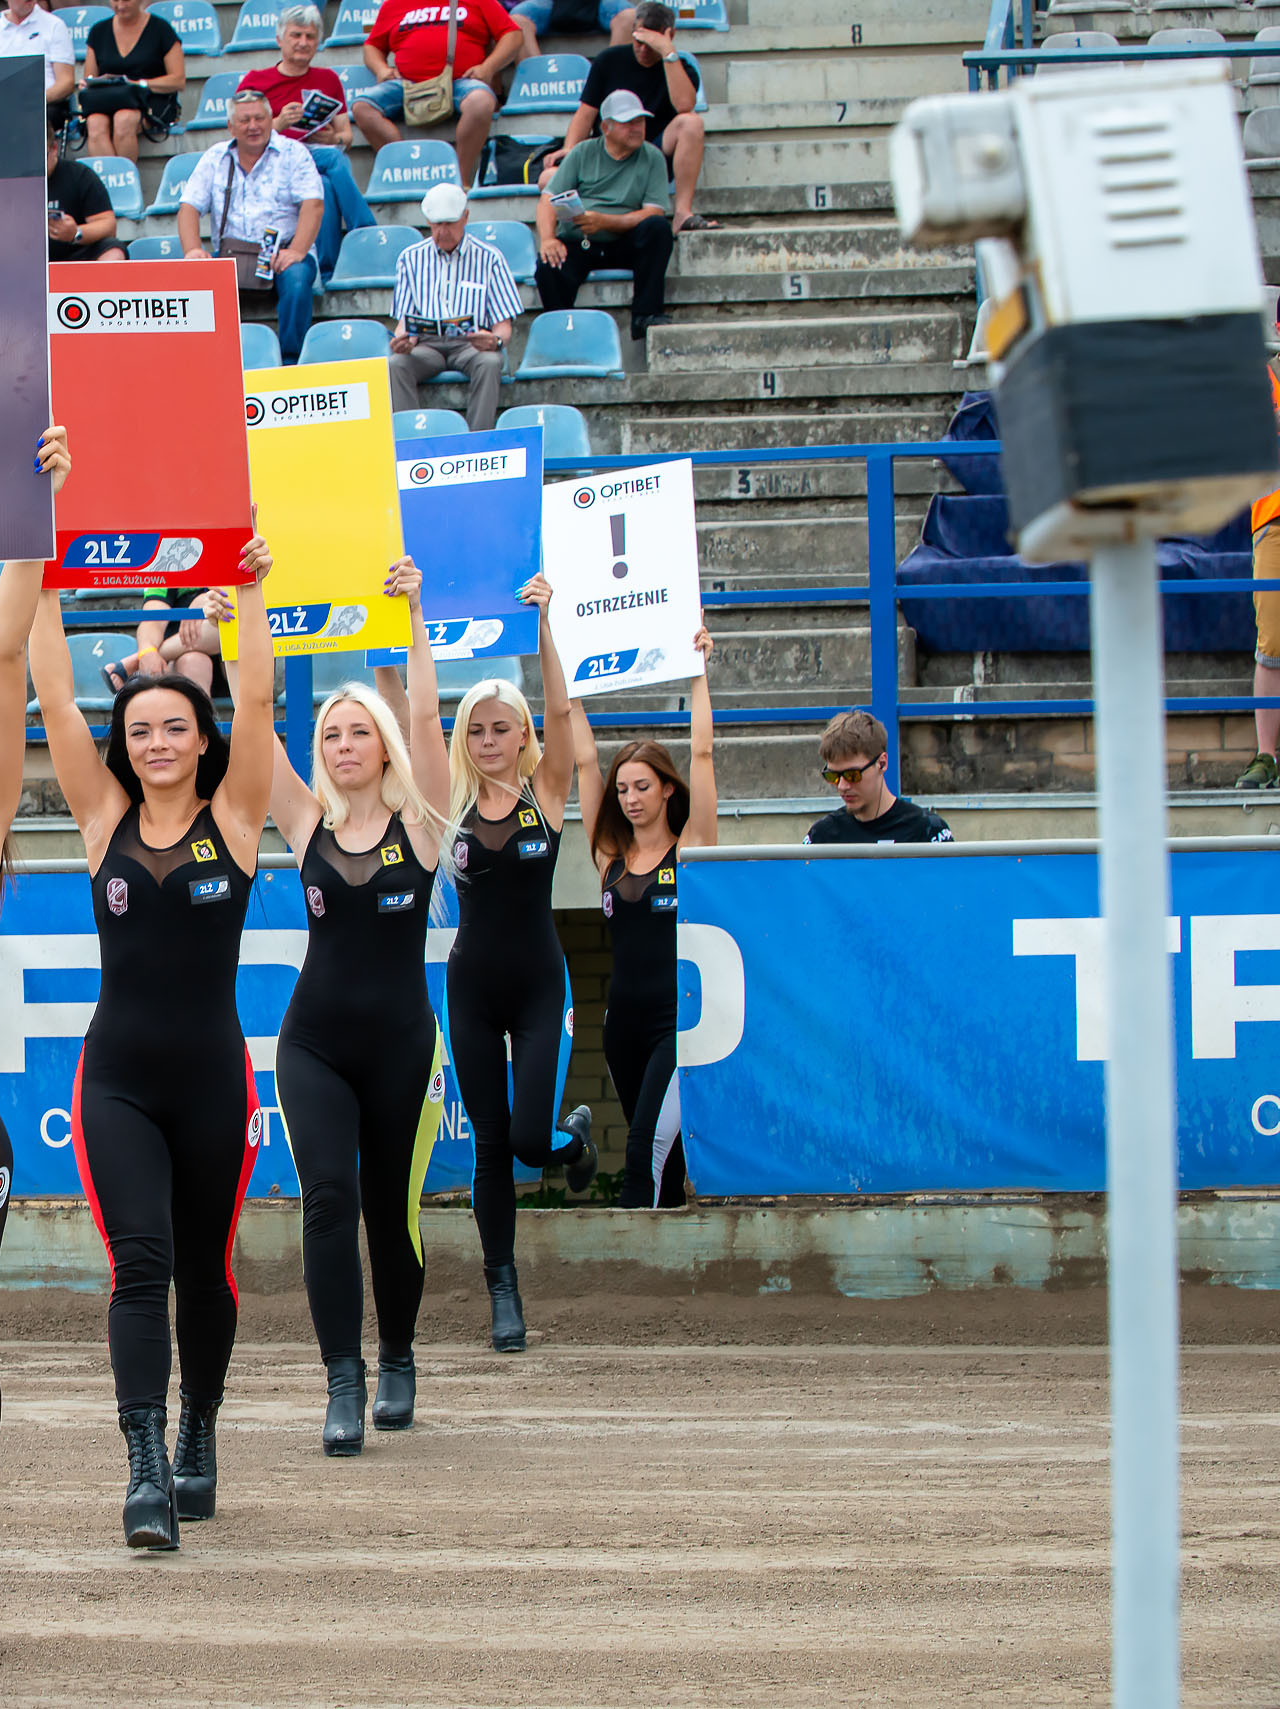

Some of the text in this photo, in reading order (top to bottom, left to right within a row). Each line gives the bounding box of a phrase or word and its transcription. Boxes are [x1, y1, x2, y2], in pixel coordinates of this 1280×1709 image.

[77, 11, 84, 23] 7
[399, 7, 440, 26] JUST
[851, 24, 862, 45] 8
[548, 59, 558, 72] 2
[836, 103, 847, 122] 7
[410, 145, 420, 159] 3
[815, 187, 826, 207] 6
[377, 230, 388, 245] 3
[790, 275, 801, 297] 5
[98, 298, 189, 319] OPTIBET
[341, 325, 352, 340] 3
[566, 315, 573, 330] 1
[764, 372, 775, 395] 4
[271, 391, 348, 415] OPTIBET
[415, 414, 426, 429] 2
[440, 456, 508, 475] OPTIBET
[600, 476, 661, 498] OPTIBET
[738, 469, 750, 494] 3
[84, 535, 131, 564] 2LŻ
[102, 576, 121, 585] LIGA
[123, 573, 166, 585] ŻUŻLOWA
[576, 588, 669, 618] OSTRZEŻENIE
[269, 607, 308, 635] 2LŻ
[424, 623, 447, 645] LŻ
[92, 640, 104, 658] 4
[588, 652, 620, 677] 2LŻ
